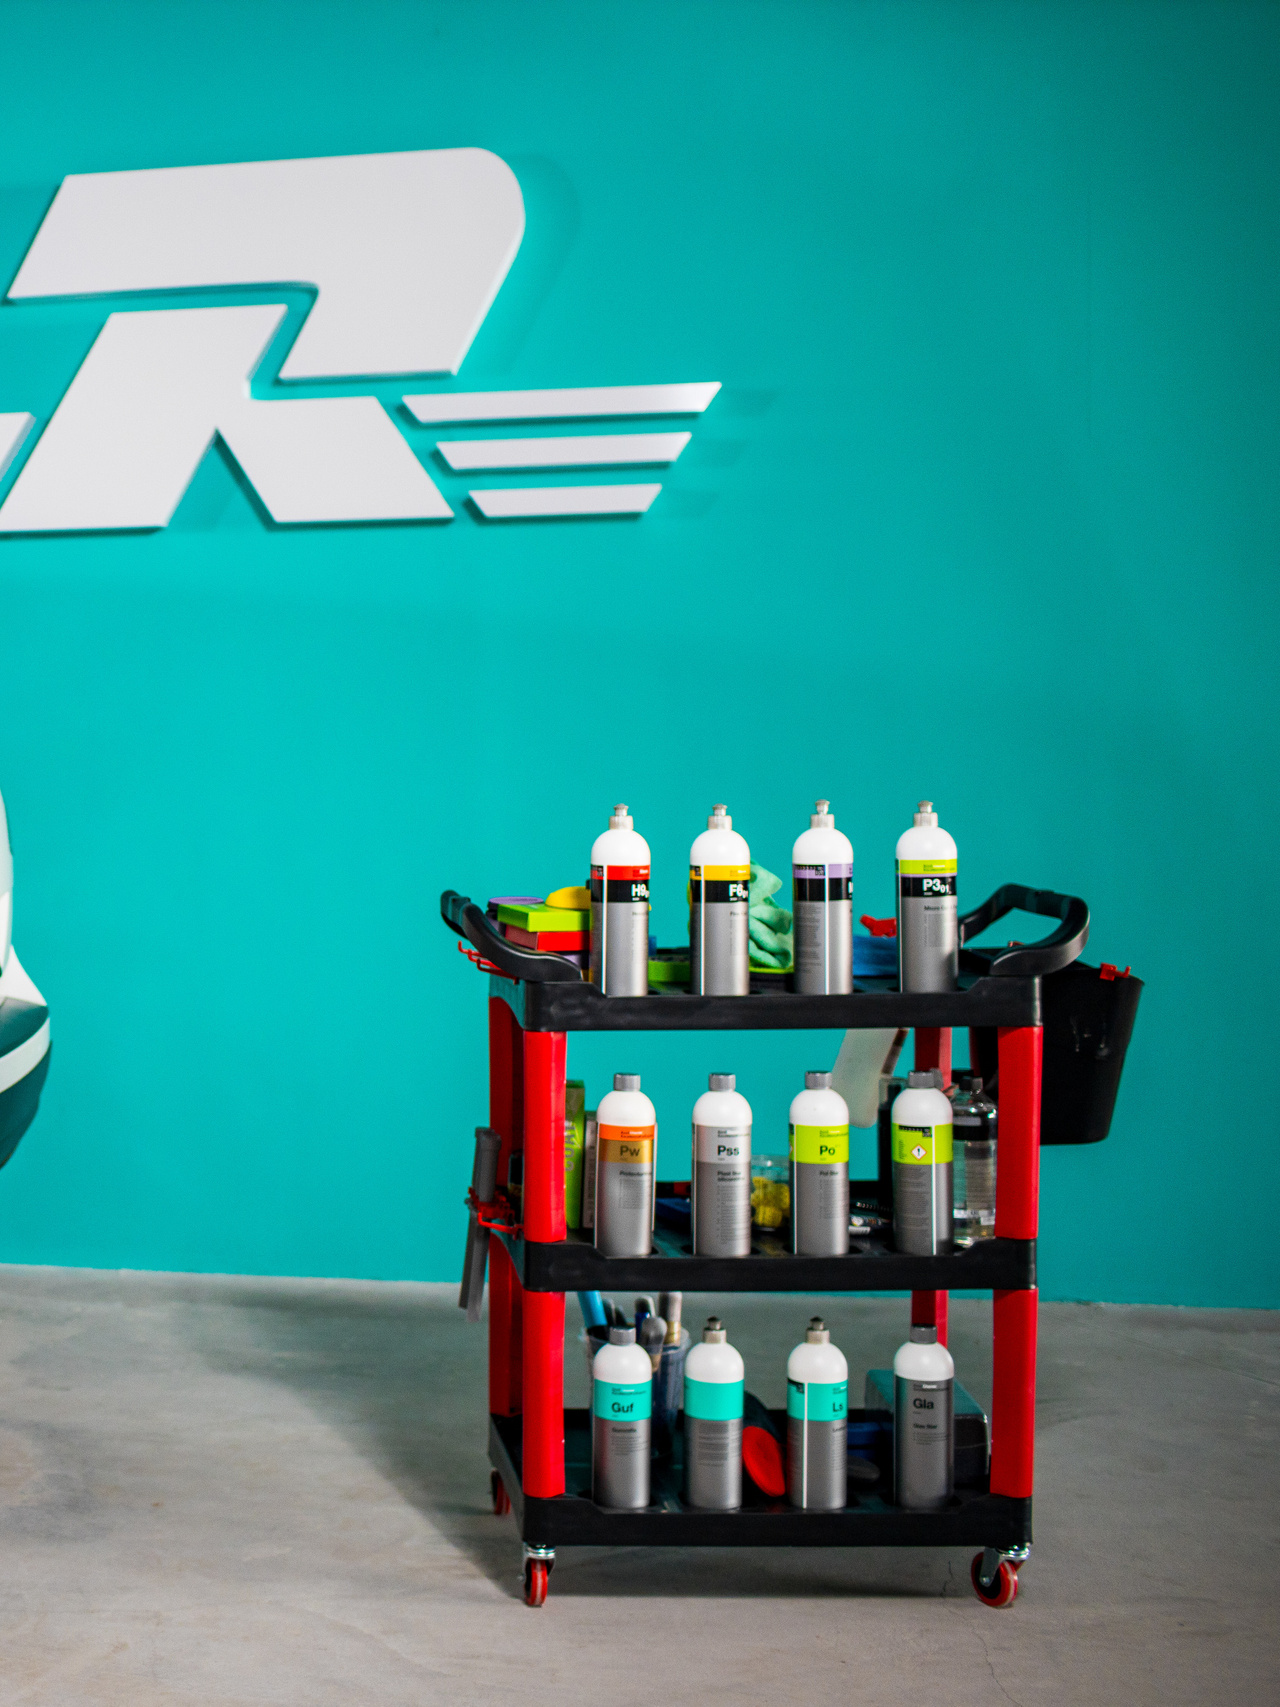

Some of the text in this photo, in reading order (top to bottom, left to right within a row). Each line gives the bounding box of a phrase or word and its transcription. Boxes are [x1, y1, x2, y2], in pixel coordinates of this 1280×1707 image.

[620, 1145, 640, 1156] Pw
[717, 1145, 740, 1156] Pss
[819, 1145, 836, 1156] Po
[611, 1402, 634, 1413] Guf
[913, 1398, 935, 1409] Gla
